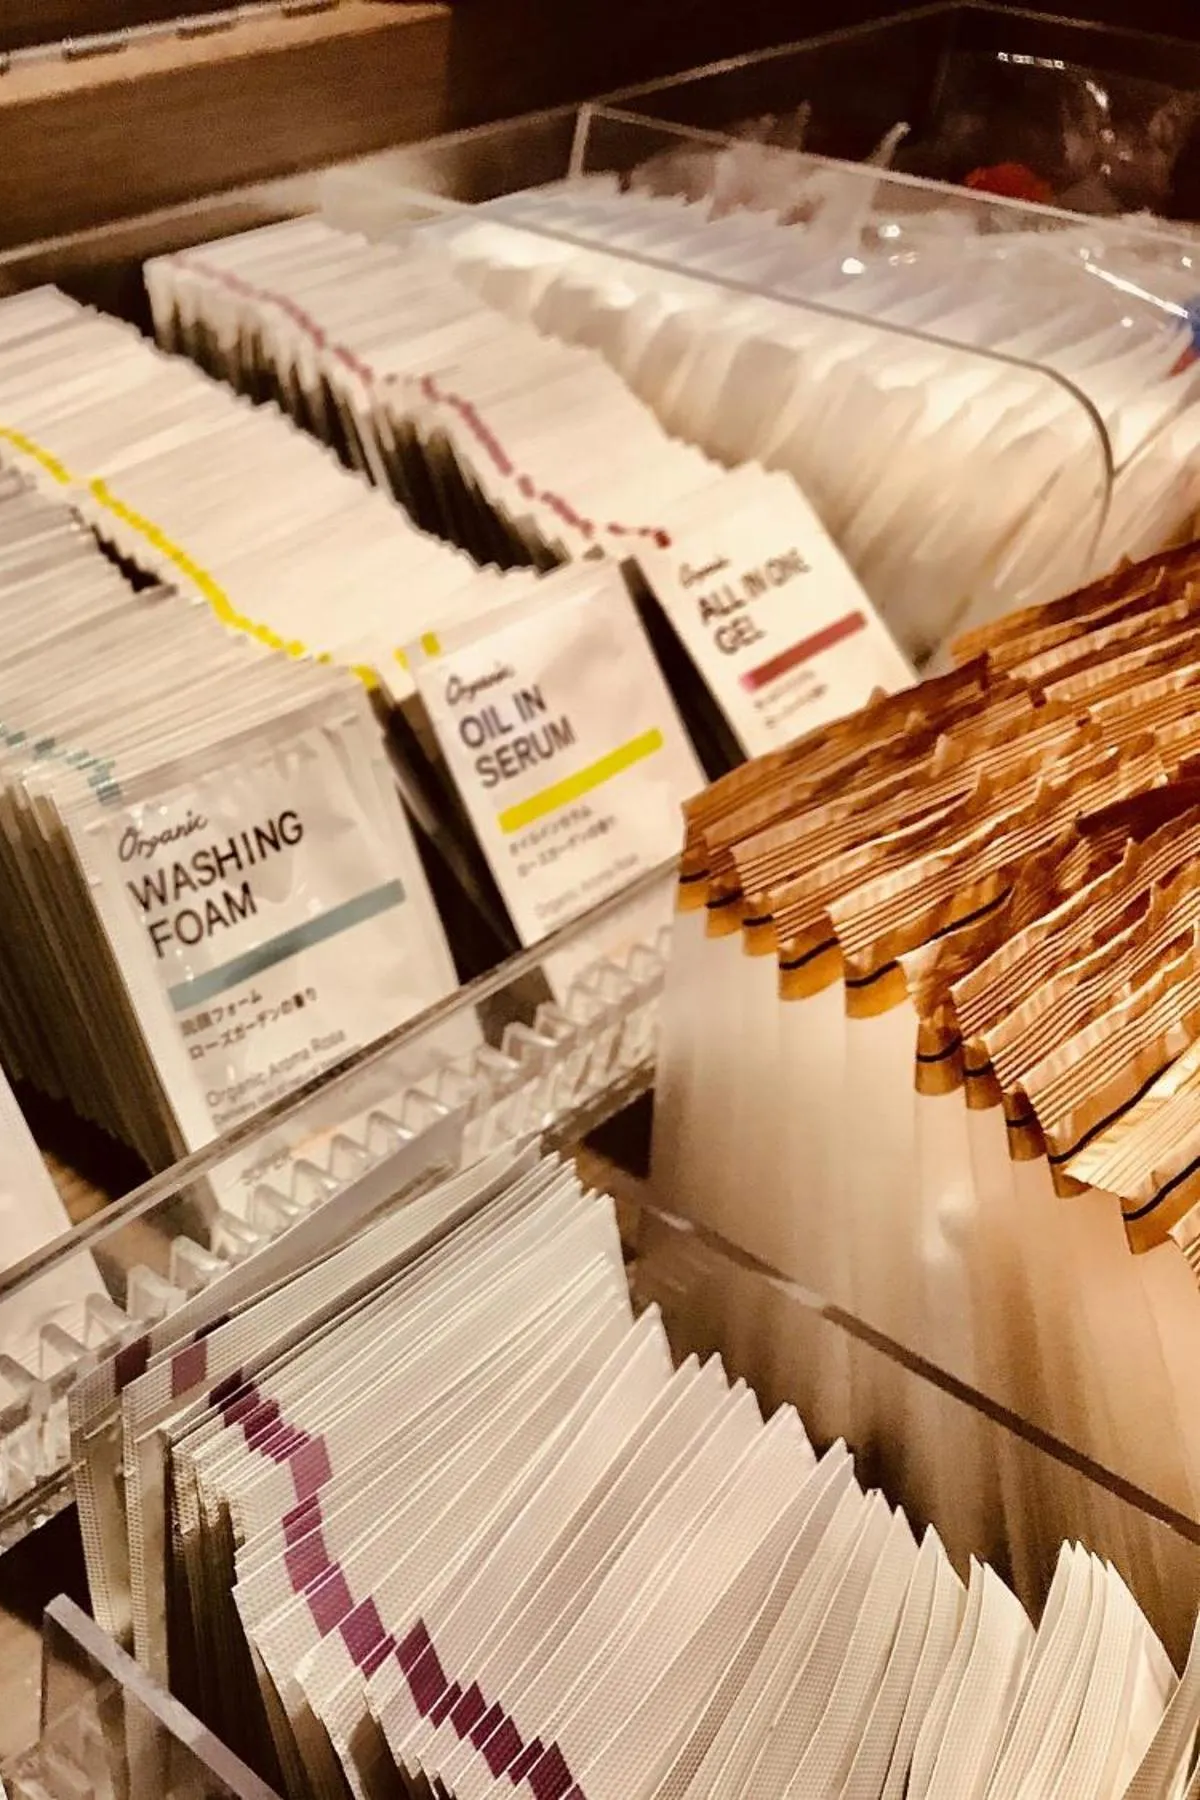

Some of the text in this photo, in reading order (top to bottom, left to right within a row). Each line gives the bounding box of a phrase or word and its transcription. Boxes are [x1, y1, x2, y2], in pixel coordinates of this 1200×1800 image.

[459, 684, 547, 749] OIL IN
[475, 715, 577, 788] SERUM
[119, 810, 208, 862] Organic
[128, 810, 304, 912] WASHING
[148, 882, 258, 959] FOAM
